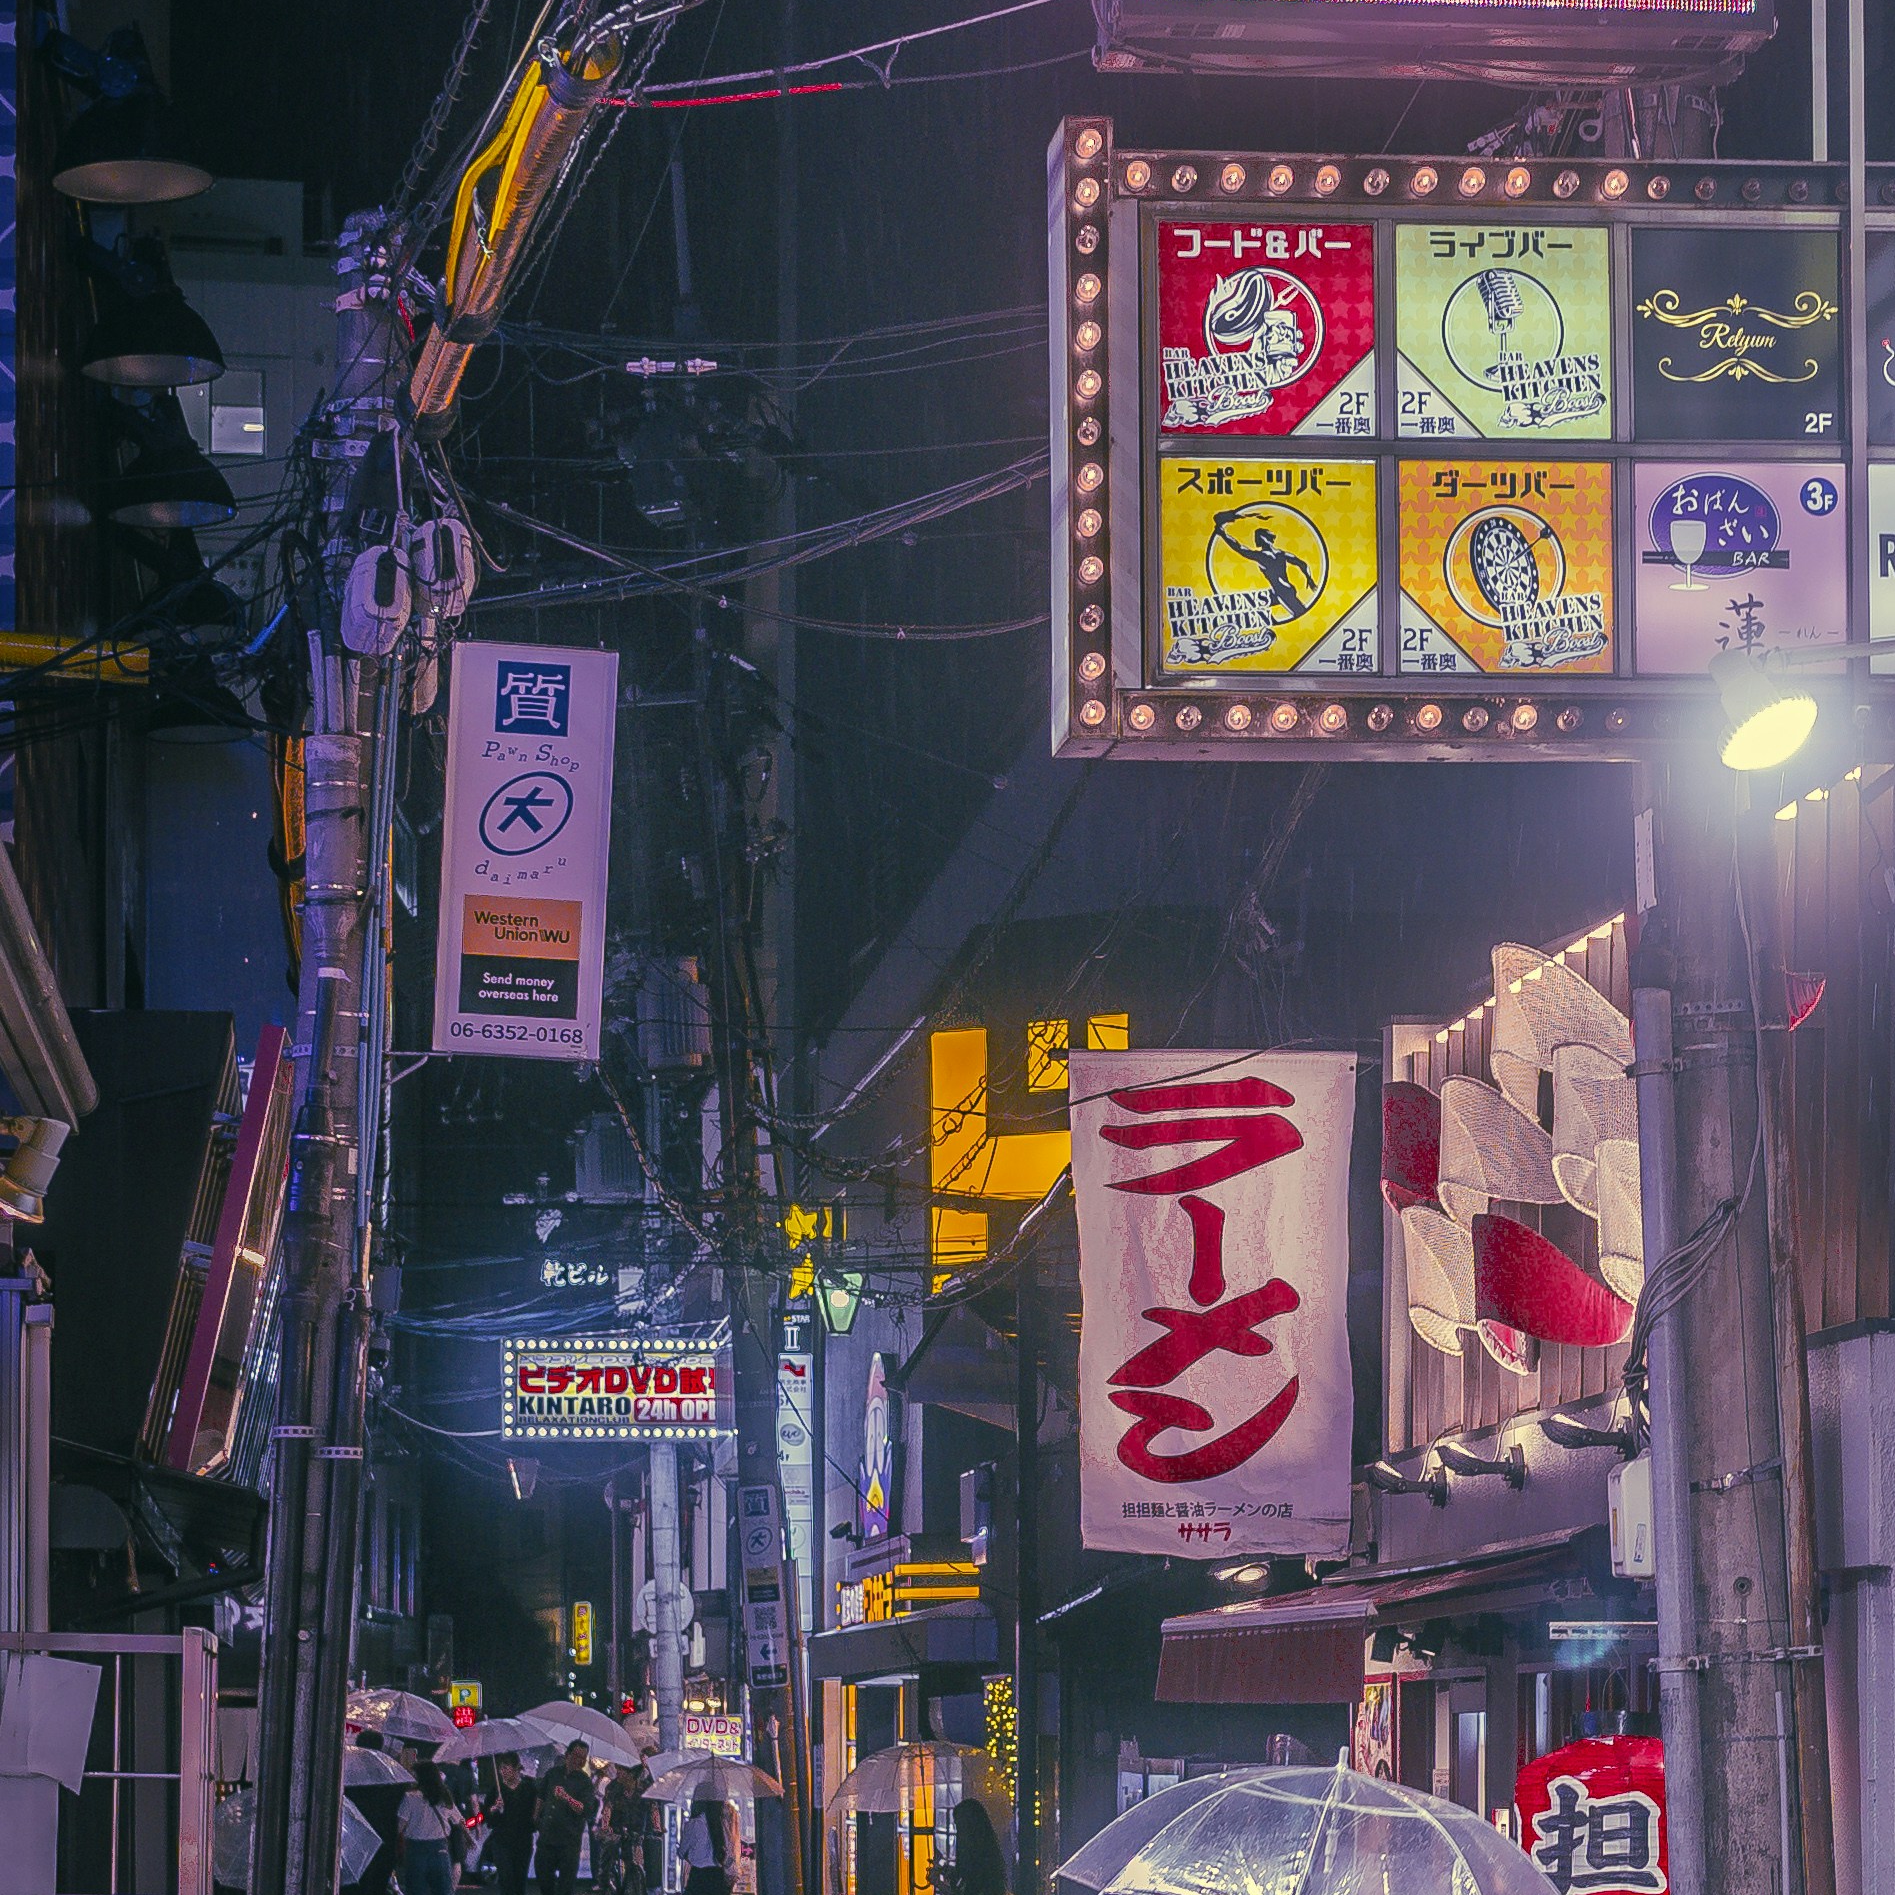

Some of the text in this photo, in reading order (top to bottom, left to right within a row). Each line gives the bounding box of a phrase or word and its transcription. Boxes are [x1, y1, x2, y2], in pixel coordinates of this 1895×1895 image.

[1173, 228, 1353, 261] フード&バー
[1429, 229, 1574, 260] ライブバー
[1163, 352, 1267, 383] HEAVENS
[1500, 353, 1601, 385] HEAVENS
[1339, 391, 1369, 416] 2F
[1402, 390, 1432, 416] 2F
[1805, 412, 1832, 434] 2F
[1177, 466, 1352, 498] スポーツバー
[1433, 468, 1575, 501] ダーツバー
[1806, 481, 1834, 510] 3F
[1731, 551, 1771, 566] BAR
[1167, 589, 1273, 622] HEAVENS
[1501, 593, 1601, 625] HEAVENS
[1341, 627, 1372, 653] 2F
[1403, 627, 1432, 653] 2F
[501, 672, 566, 730] 質
[482, 740, 580, 774] Pawn Shop
[474, 856, 568, 886] daimaru
[474, 910, 540, 929] Western
[494, 926, 539, 944] Union
[483, 970, 555, 991] Send money
[478, 988, 559, 1003] overseas here
[450, 1022, 584, 1045] 06-6352-0168
[1098, 1077, 1304, 1486] ラーメン
[518, 1366, 715, 1394] ビデオDVD試
[517, 1396, 678, 1422] KINTARO 24h
